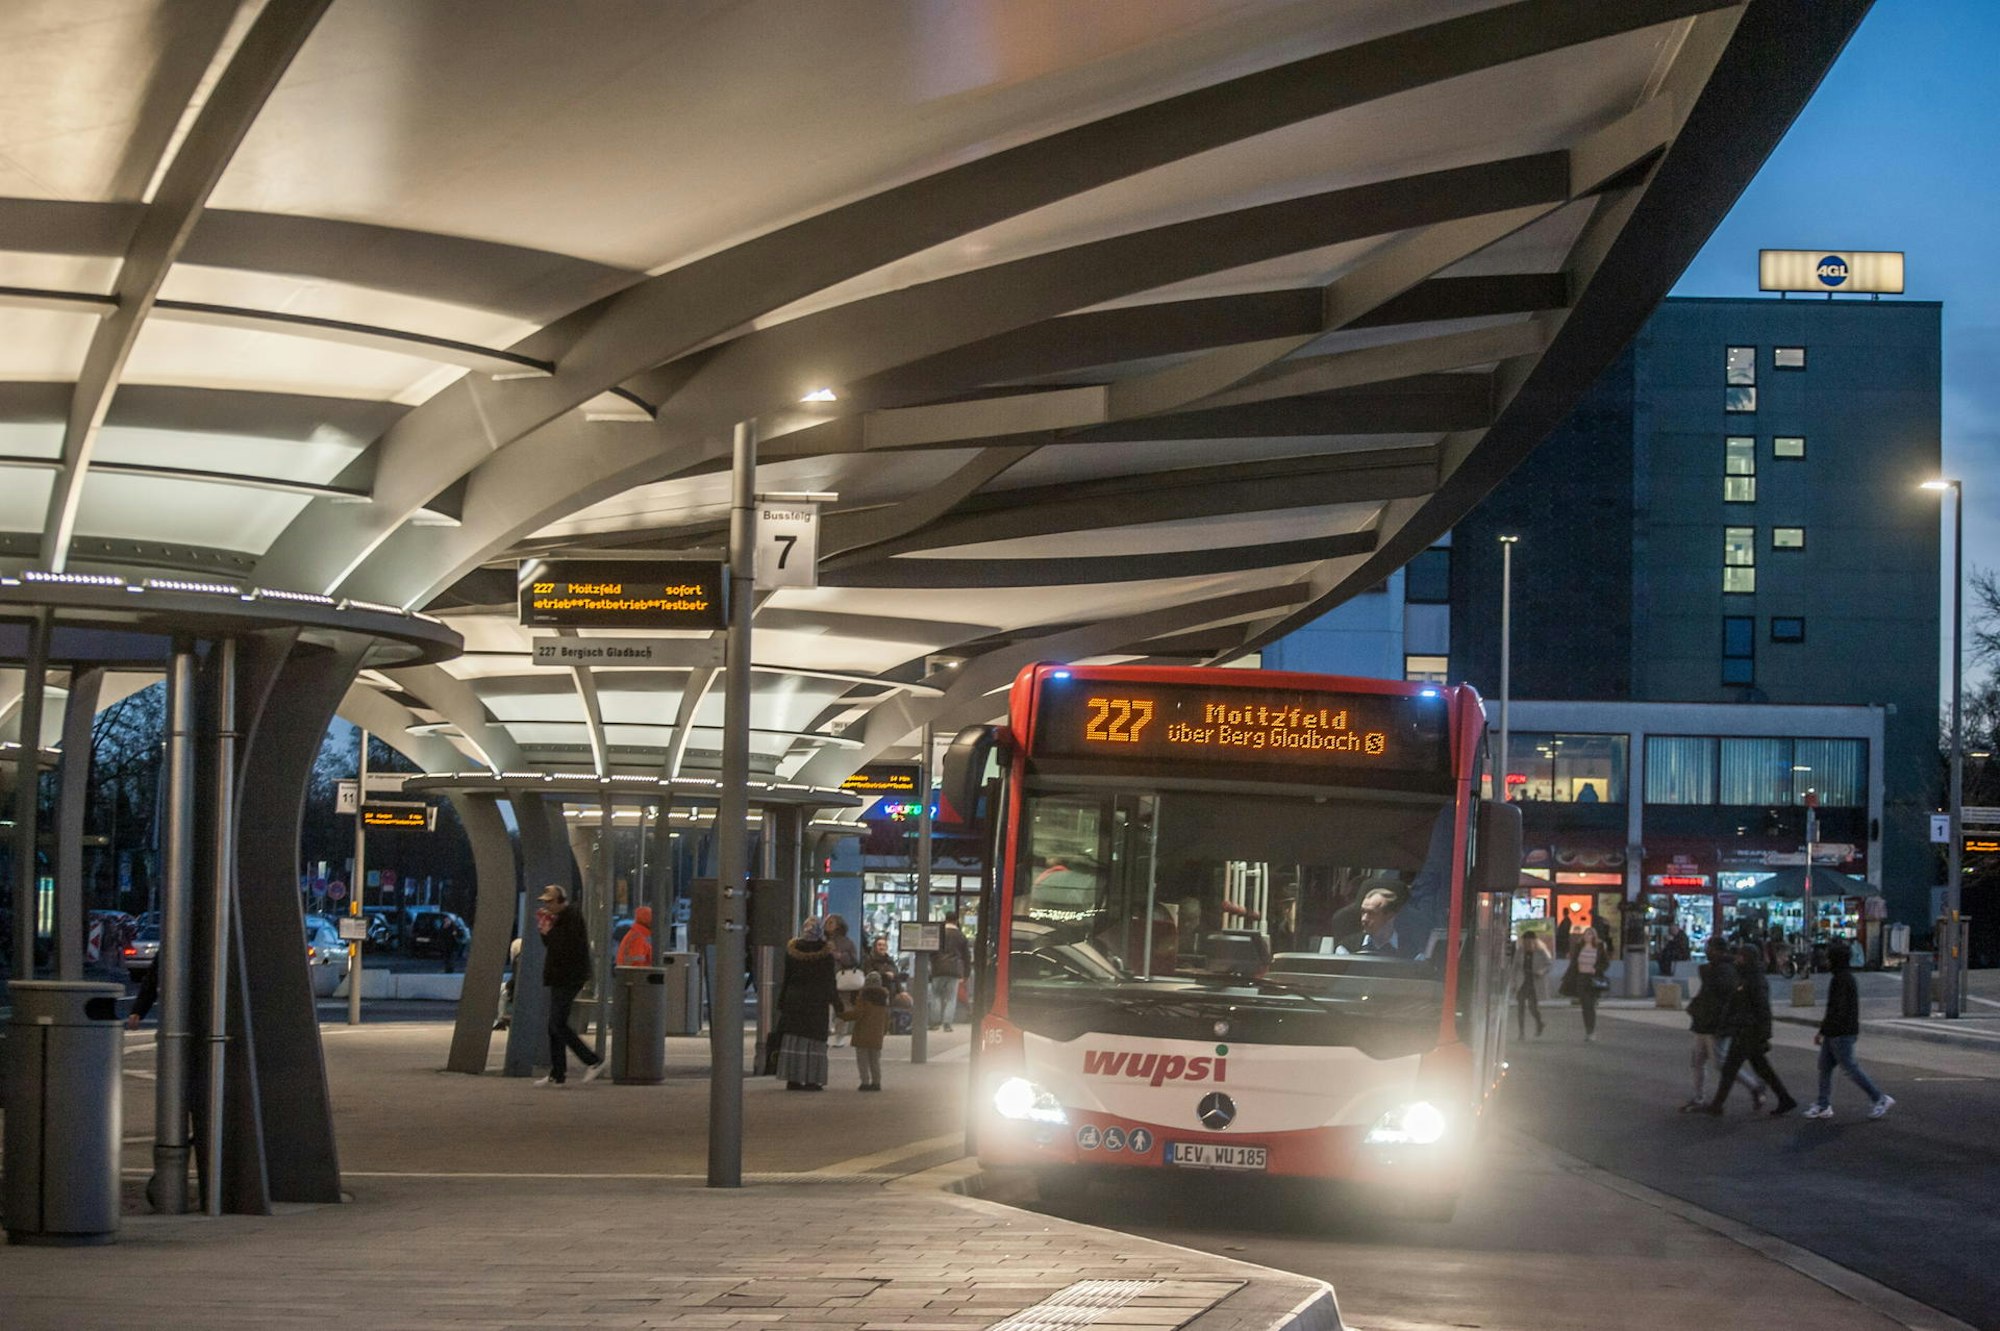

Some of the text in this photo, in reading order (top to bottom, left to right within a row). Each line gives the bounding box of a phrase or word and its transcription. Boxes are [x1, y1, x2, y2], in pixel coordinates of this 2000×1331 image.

[1817, 264, 1849, 277] AGL
[763, 510, 811, 523] Bussteig
[774, 535, 797, 569] 7
[533, 583, 703, 597] 227 Moitzfeld sofort
[539, 646, 652, 659] 227 Bergisch Gladbach
[1086, 698, 1347, 742] 227 Moitzfeld
[1168, 722, 1214, 743] über
[1219, 725, 1266, 748] Berg
[1270, 728, 1360, 751] Gladbach
[343, 793, 354, 803] 11
[1937, 825, 1943, 837] 1
[1083, 1044, 1229, 1087] wupsi
[1175, 1145, 1265, 1166] LEV WU 185
